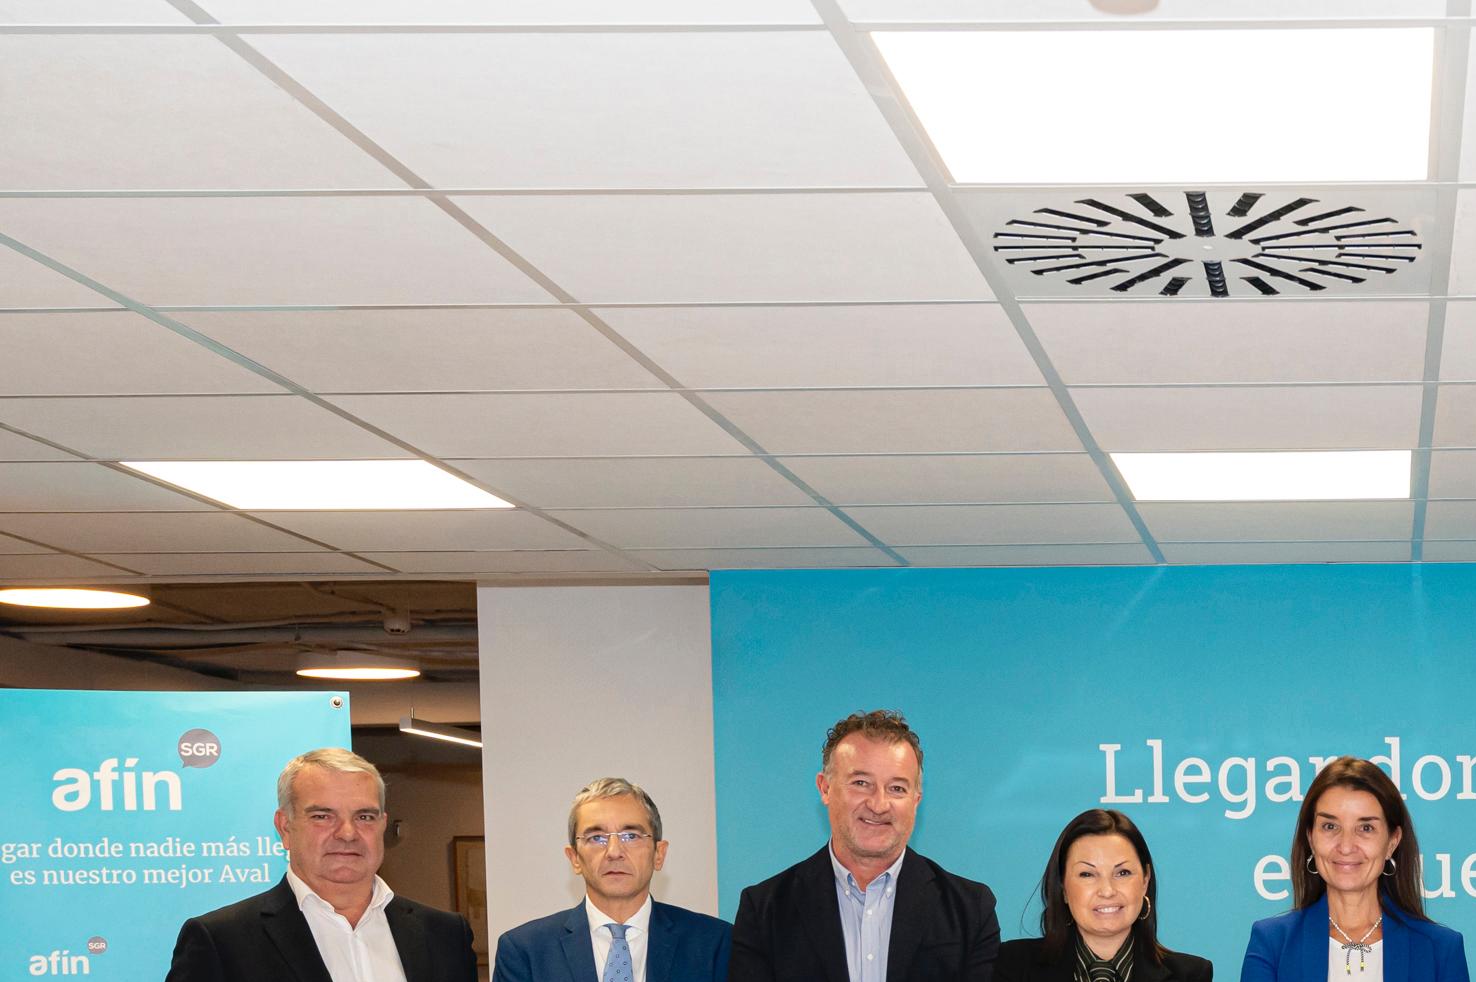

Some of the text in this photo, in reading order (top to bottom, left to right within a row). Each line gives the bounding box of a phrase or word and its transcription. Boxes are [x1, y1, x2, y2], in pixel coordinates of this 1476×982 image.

[51, 742, 218, 812] afín SGR
[1, 836, 290, 864] gar donde nadie más lle
[10, 863, 271, 888] es nuestro mejor Aval
[1253, 854, 1290, 901] e
[29, 942, 106, 976] afín SGR
